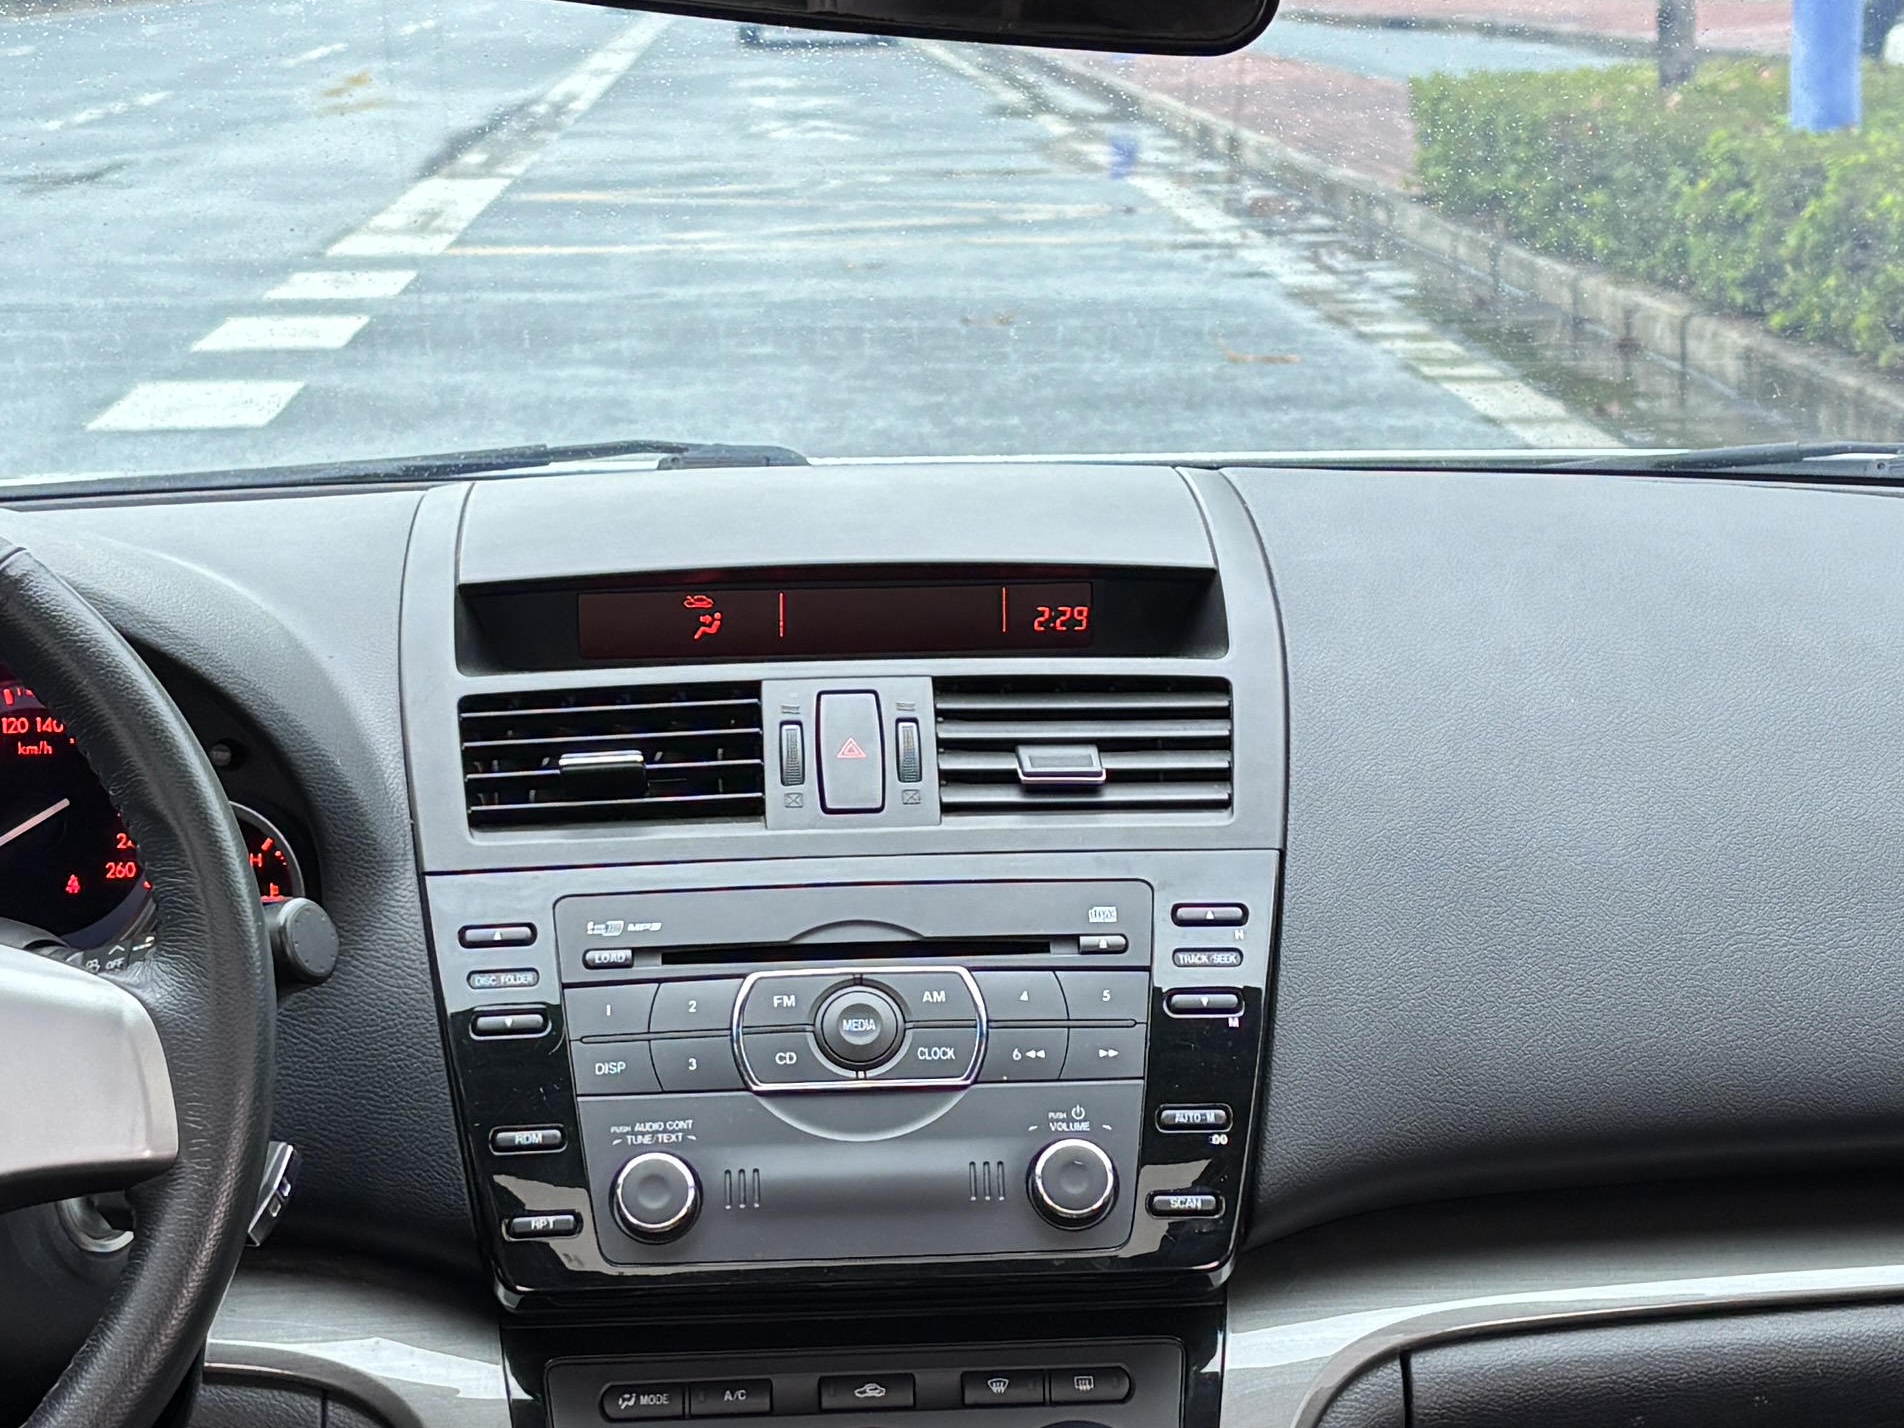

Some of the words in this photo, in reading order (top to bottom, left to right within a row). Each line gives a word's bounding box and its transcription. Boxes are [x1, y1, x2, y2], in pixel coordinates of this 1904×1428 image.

[1034, 606, 1088, 631] 2:29
[1, 717, 29, 734] 120
[17, 741, 53, 755] km/h
[249, 853, 262, 867] H
[105, 862, 136, 879] 260
[595, 953, 626, 964] LOAD
[773, 994, 796, 1009] FM
[922, 989, 946, 1003] AM
[1019, 990, 1029, 1002] 4
[1102, 990, 1111, 1002] 5
[605, 1004, 611, 1016] 1
[688, 1000, 697, 1013] 2
[842, 1018, 877, 1032] MEDIA
[1228, 1017, 1239, 1028] M
[775, 1052, 797, 1065] CD
[917, 1046, 956, 1061] CLOCK
[1012, 1047, 1022, 1060] 6
[595, 1061, 627, 1075] DISP
[688, 1058, 697, 1071] 3
[634, 1121, 664, 1132] AUDIO
[666, 1119, 693, 1130] CONT
[1049, 1121, 1091, 1132] VOLUME
[515, 1132, 543, 1145] RDM
[626, 1132, 684, 1145] TUNE/TEXT
[1170, 1197, 1202, 1210] SCAN
[530, 1217, 556, 1230] RPT
[640, 1392, 670, 1406] MODE
[724, 1389, 747, 1403] A/C
